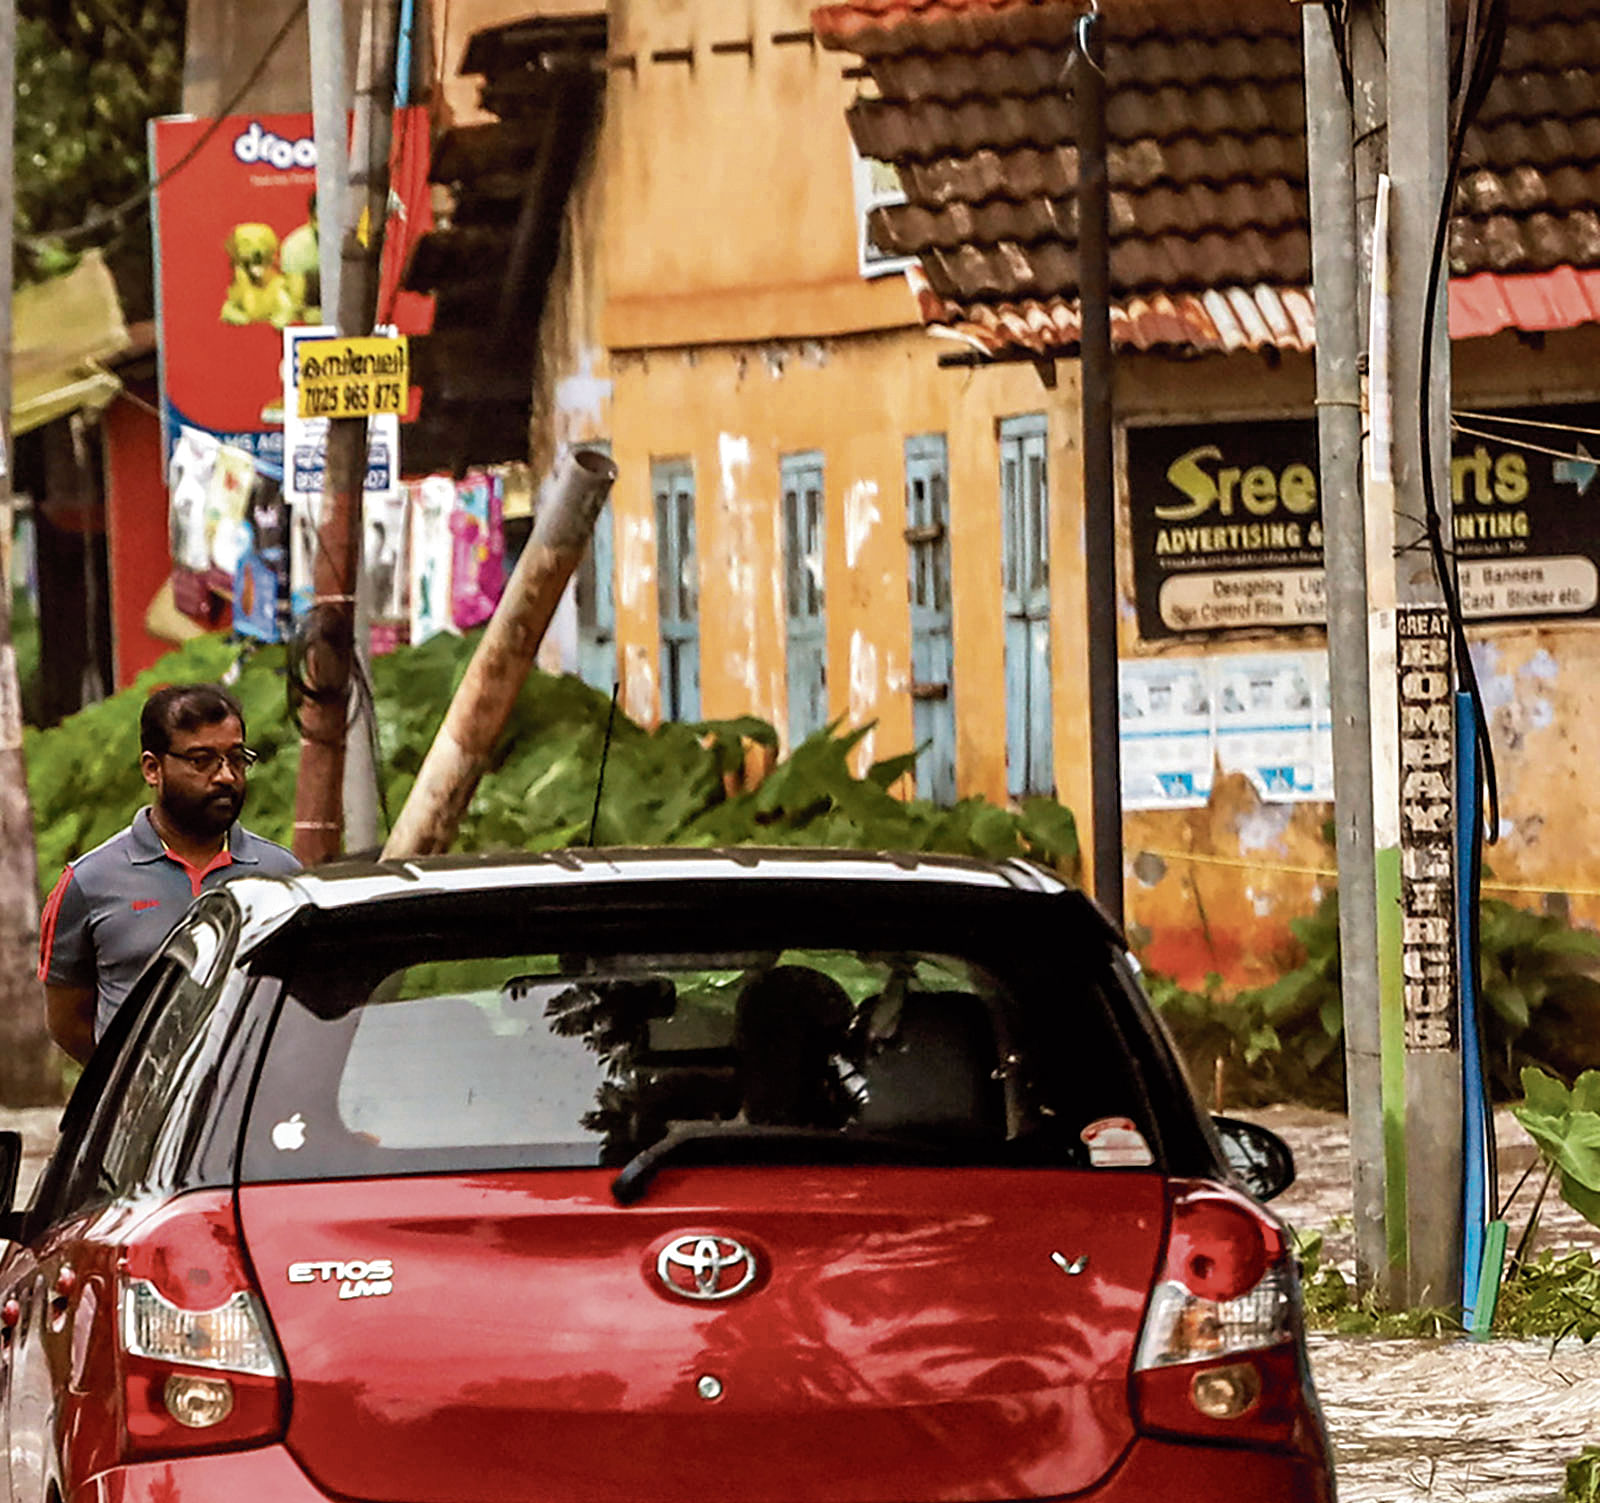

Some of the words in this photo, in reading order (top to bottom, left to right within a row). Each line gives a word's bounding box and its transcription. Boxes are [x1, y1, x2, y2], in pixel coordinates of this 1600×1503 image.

[233, 121, 318, 170] droo
[1154, 444, 1318, 521] Sree
[1451, 445, 1530, 505] rts
[1155, 522, 1300, 556] ADVERTISING
[1453, 509, 1530, 539] INTING
[1213, 577, 1283, 599] Designing
[1481, 567, 1544, 586] Banners
[1398, 613, 1449, 637] GREAT
[1399, 636, 1452, 834] BOMBAY
[288, 1260, 394, 1283] ETIOS
